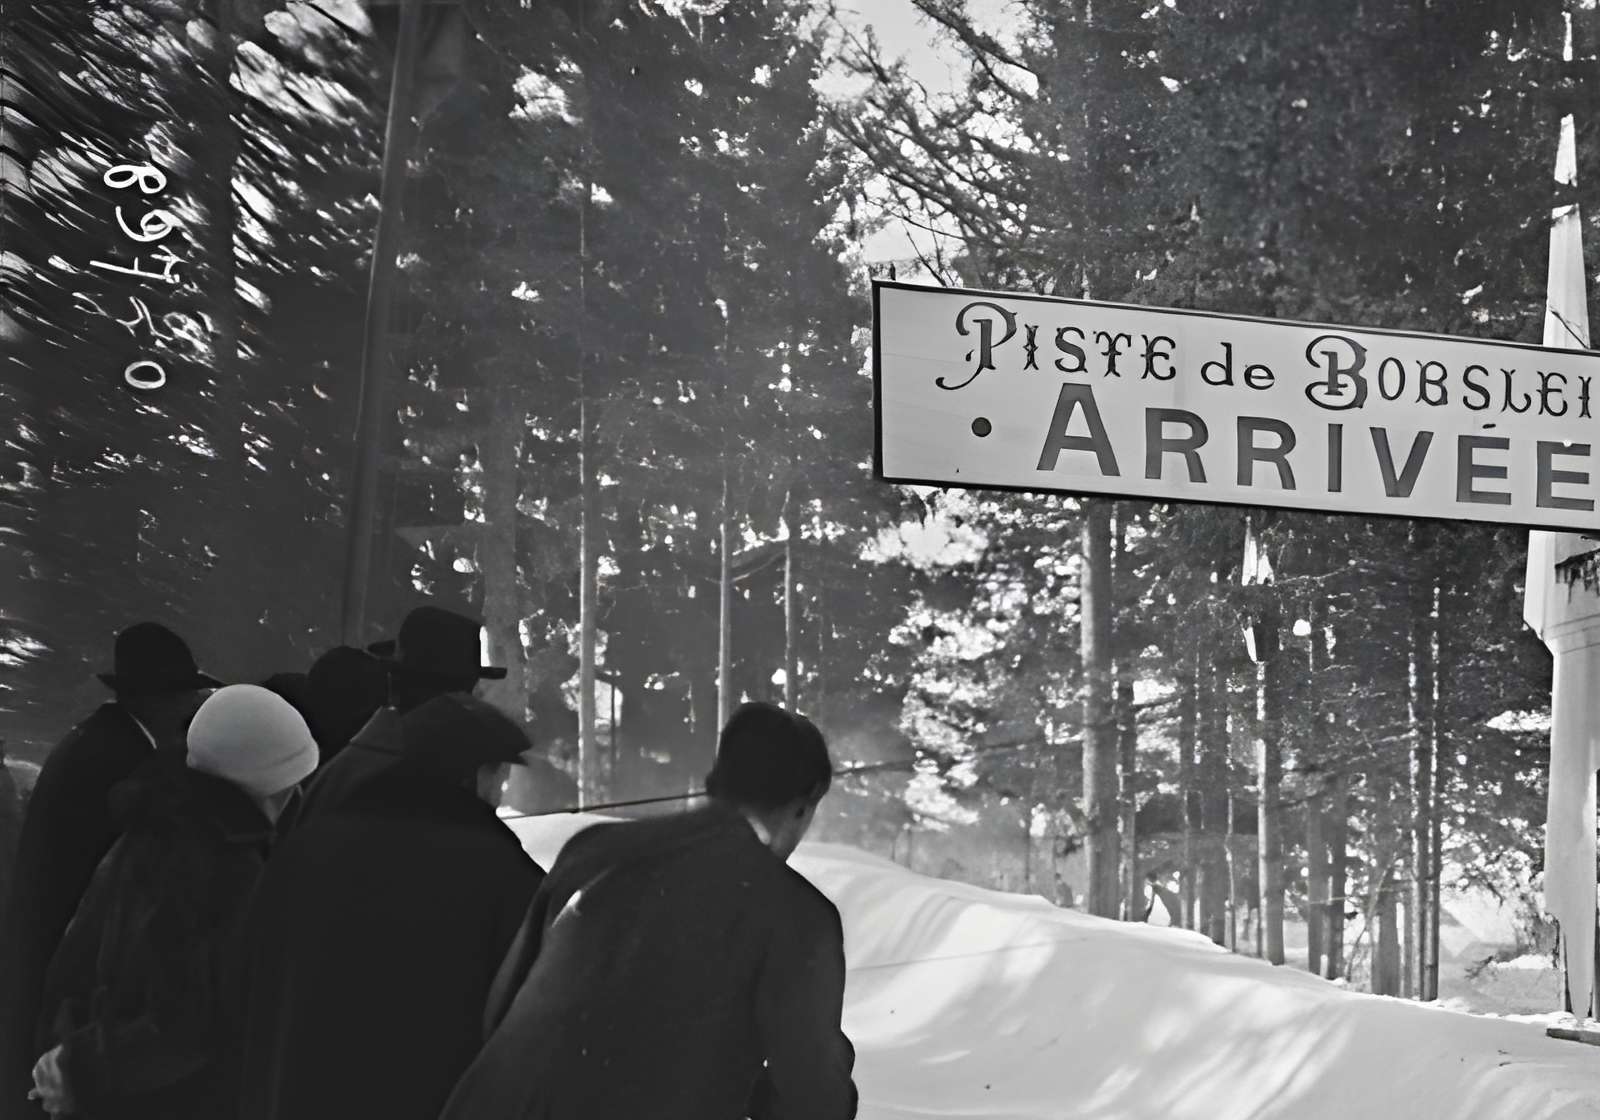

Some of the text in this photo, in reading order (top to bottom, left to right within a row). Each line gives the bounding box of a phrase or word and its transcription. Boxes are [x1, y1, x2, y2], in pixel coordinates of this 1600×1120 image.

[935, 301, 1177, 390] PISTE
[1200, 342, 1276, 391] de
[1036, 382, 1595, 511] ARRIVÉE
